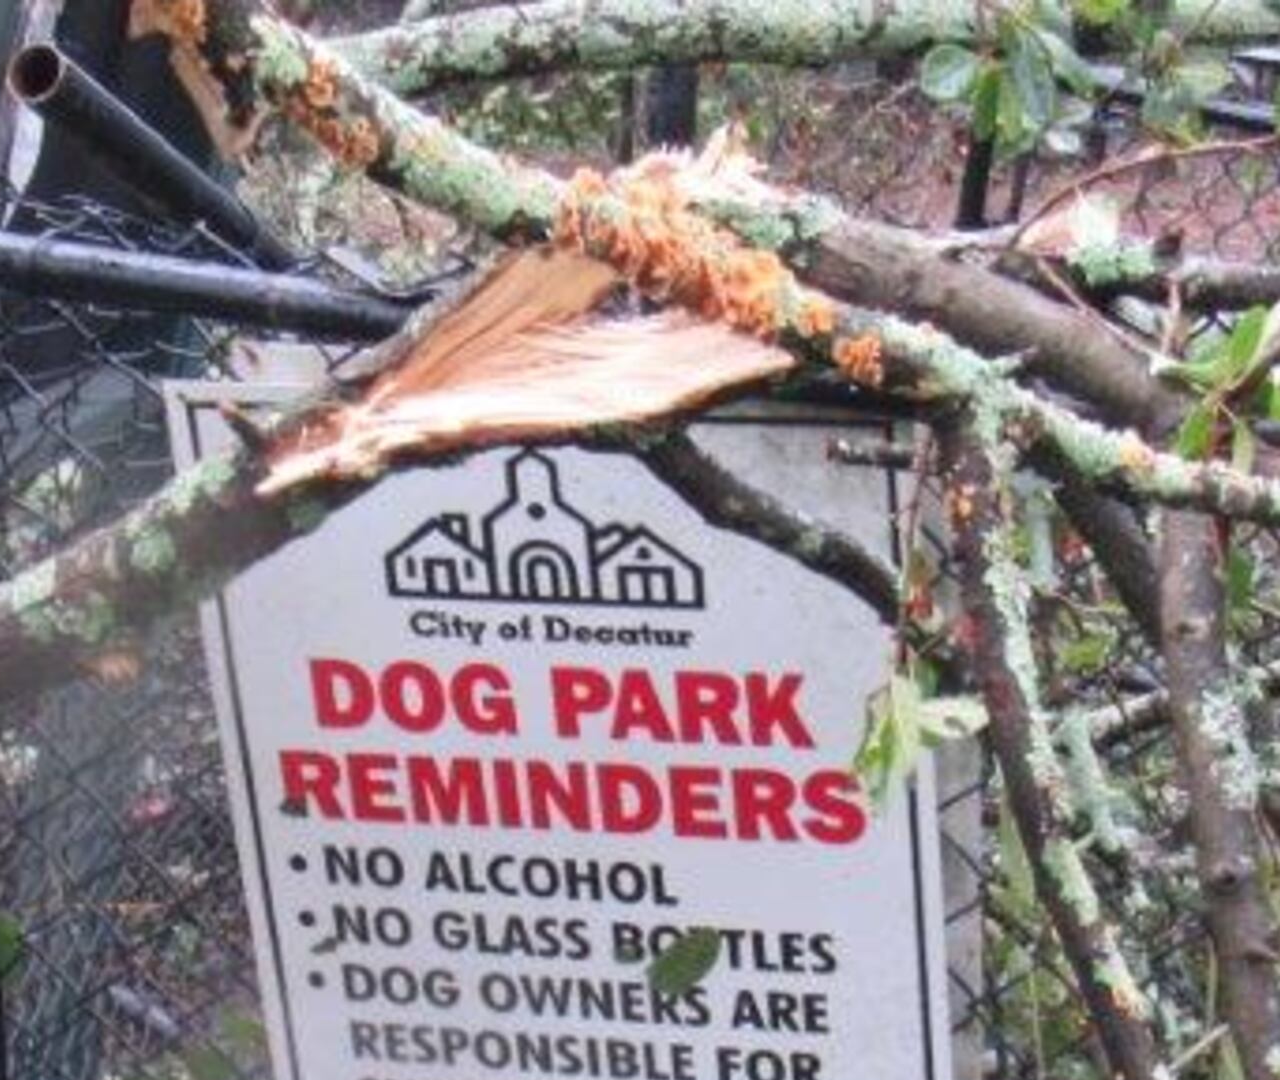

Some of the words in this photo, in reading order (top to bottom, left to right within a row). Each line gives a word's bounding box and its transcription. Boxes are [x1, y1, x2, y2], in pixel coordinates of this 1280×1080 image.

[410, 611, 486, 645] City
[497, 615, 533, 642] of
[543, 615, 693, 648] Decatur
[310, 658, 517, 736] DOG
[550, 667, 814, 749] PARK
[280, 751, 867, 844] REMINDERS
[325, 846, 404, 888] NO
[425, 854, 678, 906] ALCOHOL
[334, 906, 412, 948] NO
[433, 911, 590, 960] GLASS
[613, 922, 837, 976] BOTLES
[342, 964, 460, 1007] DOG
[480, 973, 712, 1028] OWNERS
[731, 989, 830, 1034] ARE
